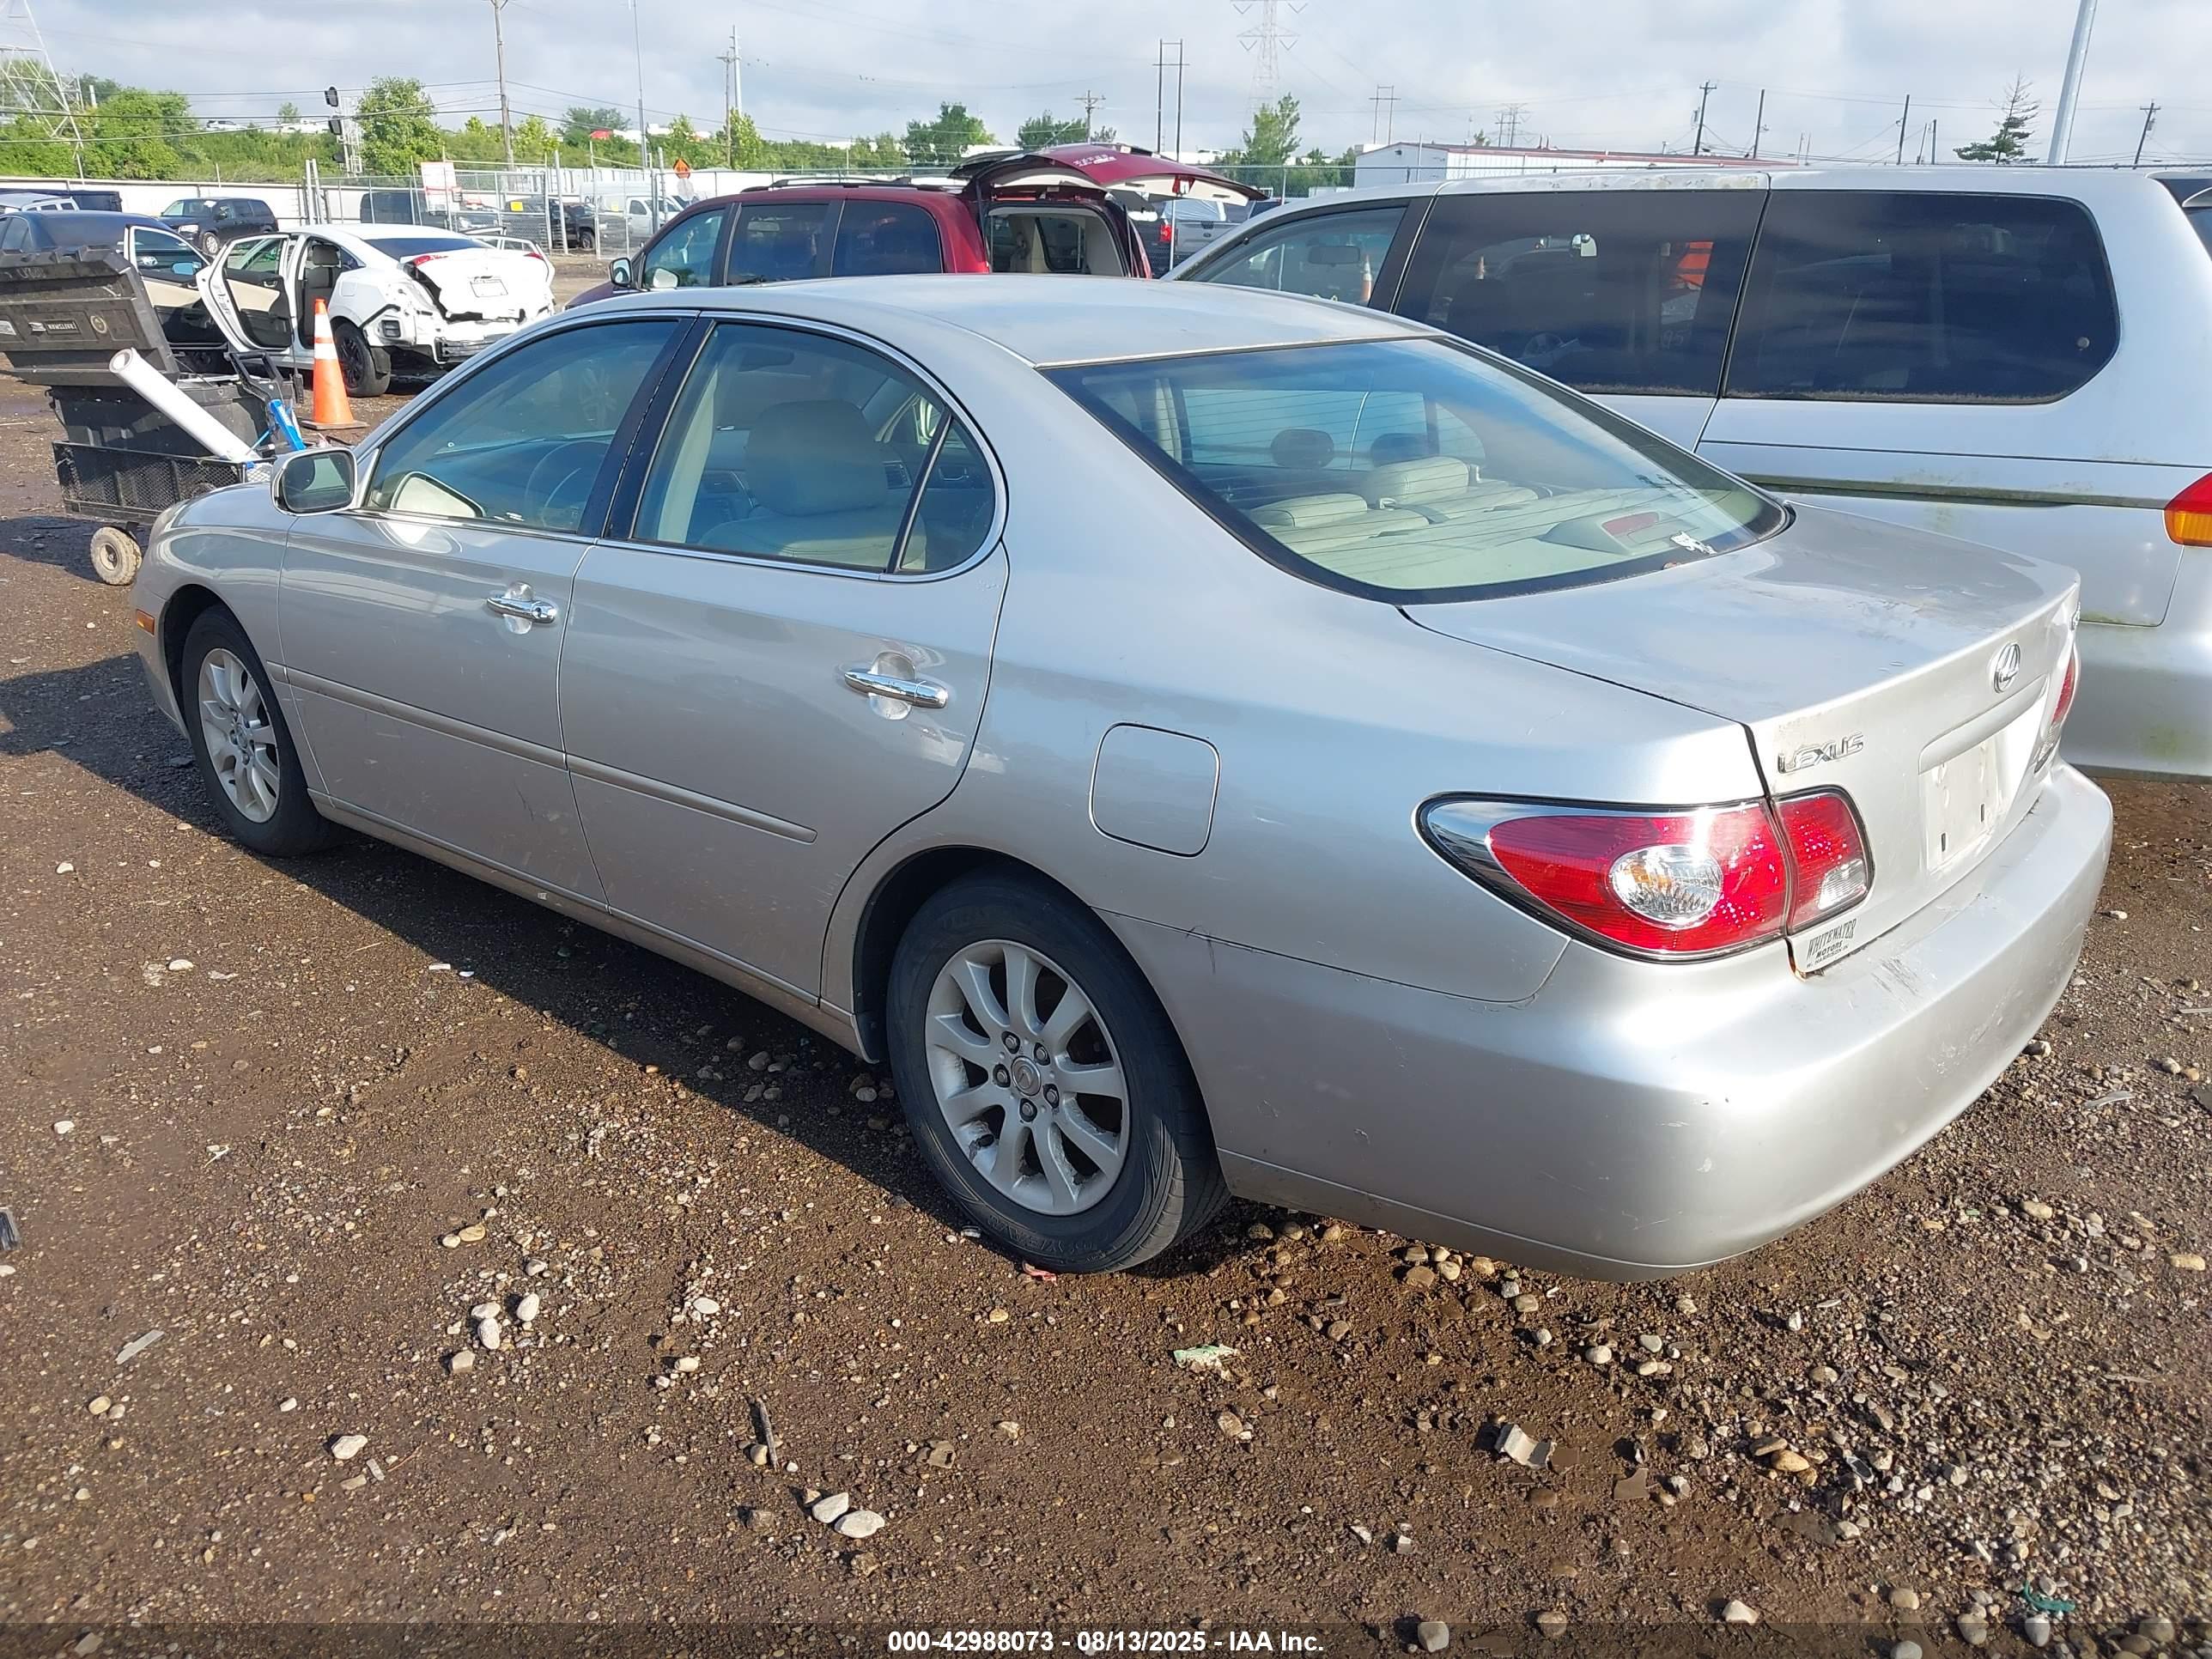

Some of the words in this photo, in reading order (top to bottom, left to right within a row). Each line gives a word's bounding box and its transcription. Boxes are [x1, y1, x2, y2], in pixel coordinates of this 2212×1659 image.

[1777, 730, 1864, 775] LEXUS
[1806, 918, 1857, 961] WHITEWATER
[1815, 940, 1844, 958] MOTORS
